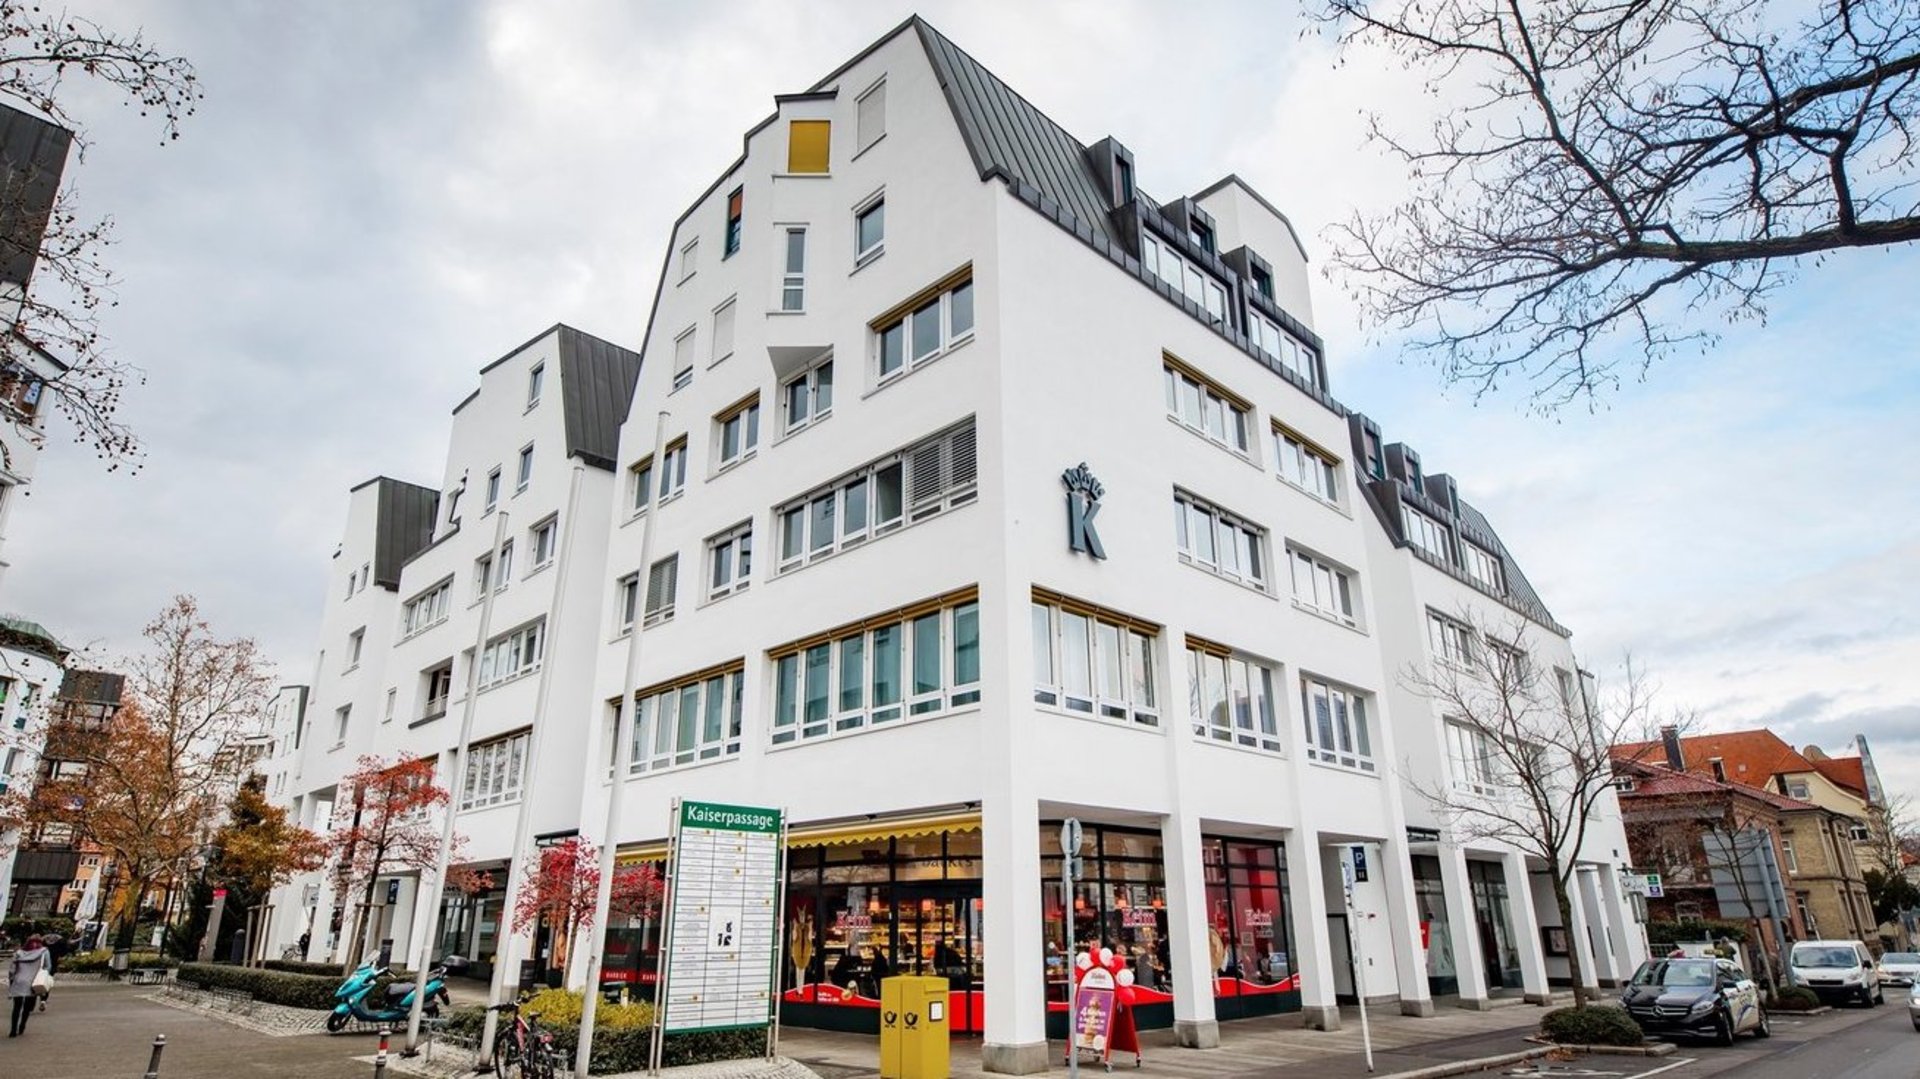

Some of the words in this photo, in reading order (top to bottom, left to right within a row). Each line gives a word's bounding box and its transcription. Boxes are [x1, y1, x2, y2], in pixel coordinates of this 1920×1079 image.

[1067, 491, 1107, 561] K
[687, 805, 773, 830] Kaiserpassage
[1355, 852, 1363, 864] P
[836, 910, 873, 929] Keim
[1121, 907, 1157, 928] Keim
[1244, 908, 1273, 926] Keim
